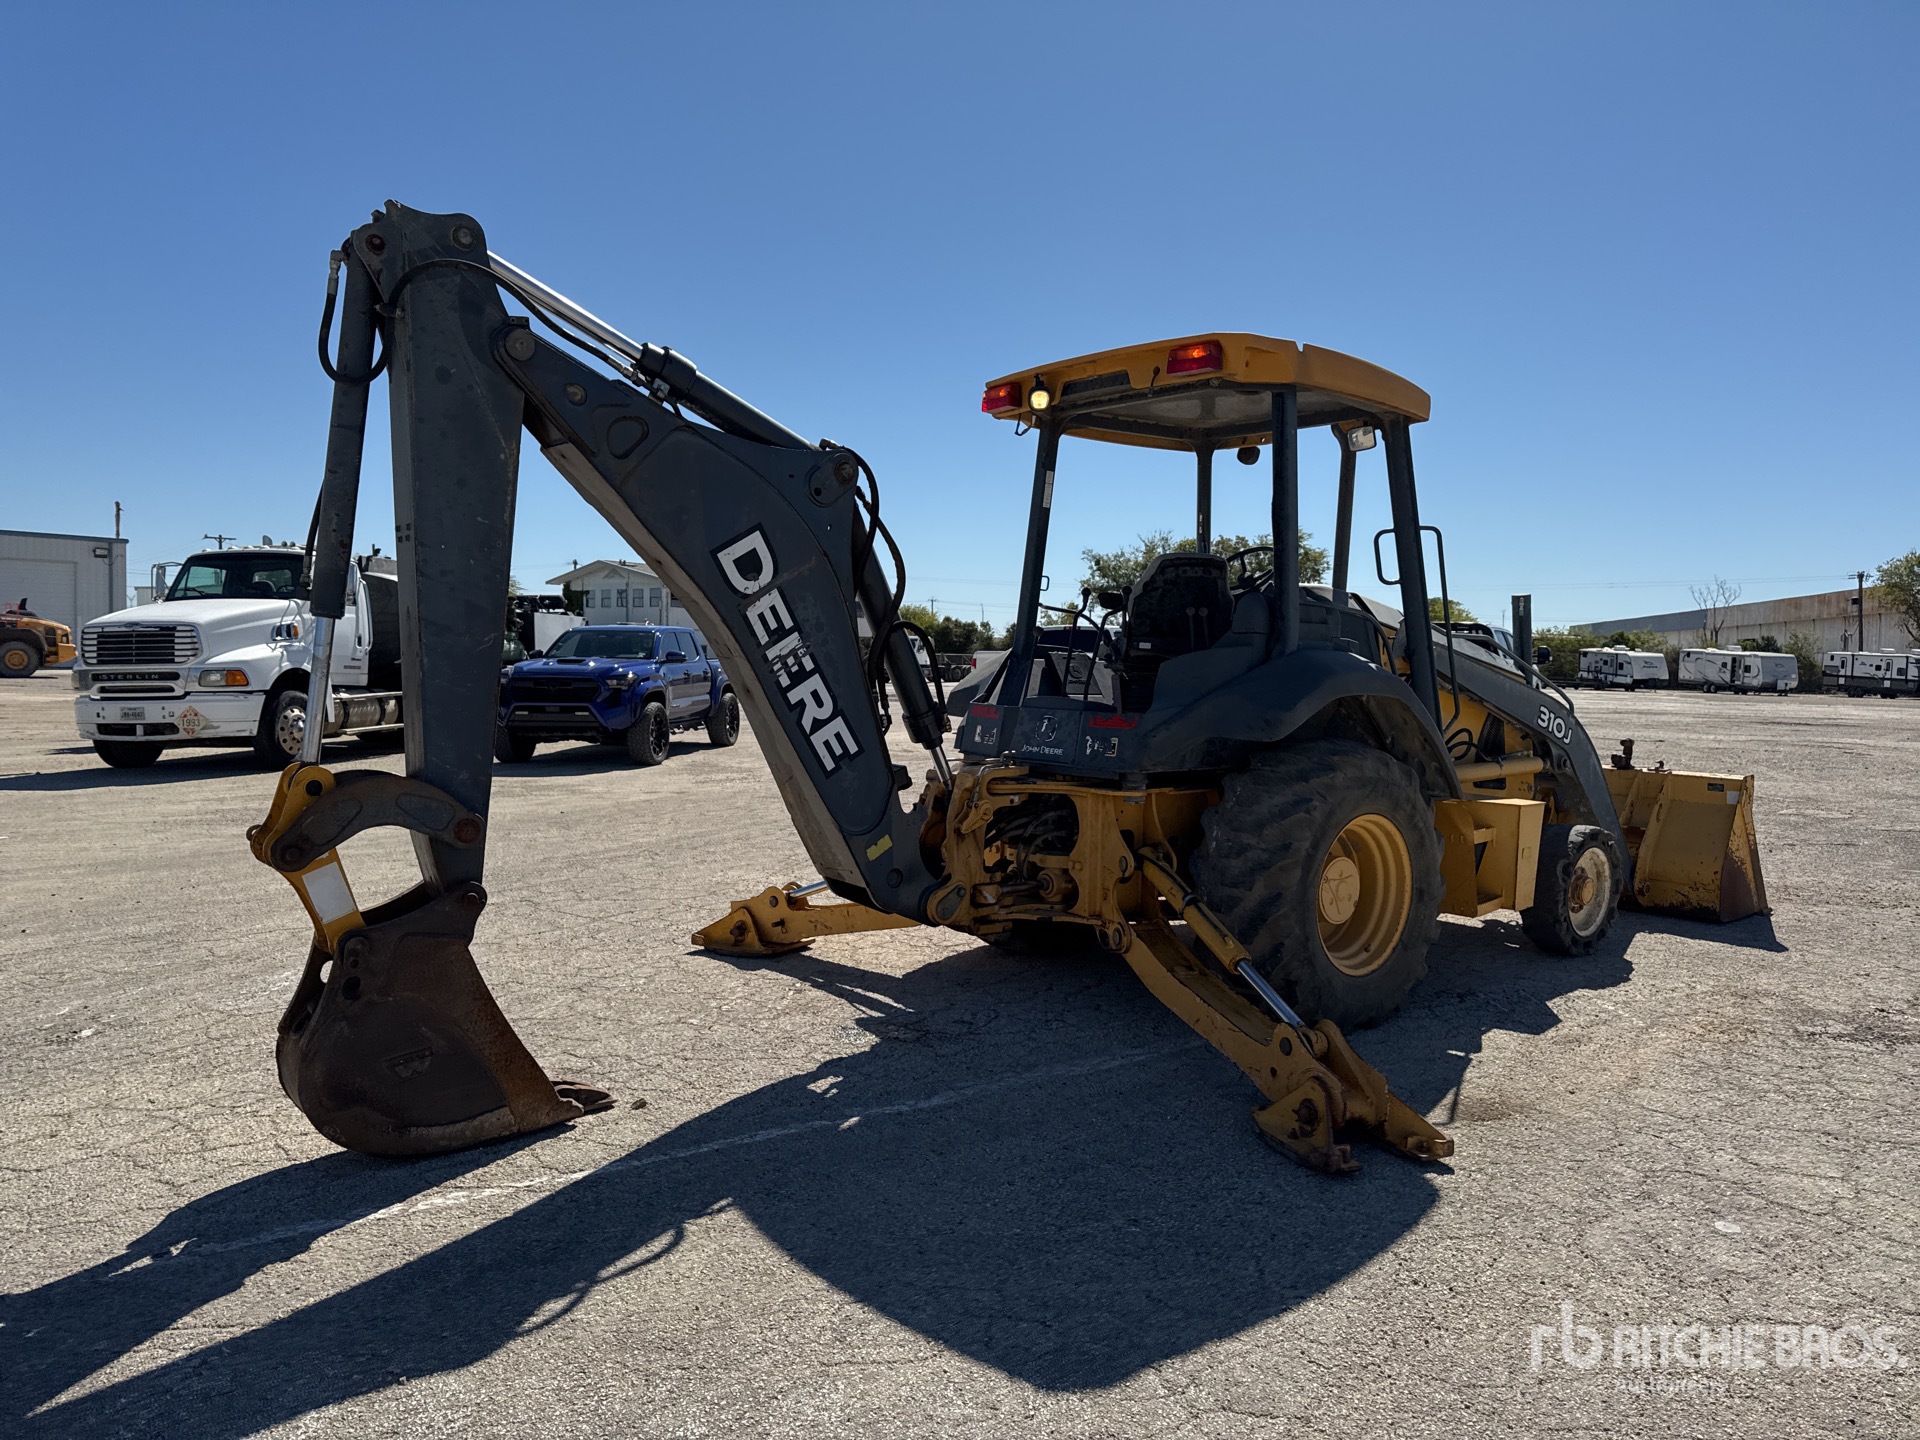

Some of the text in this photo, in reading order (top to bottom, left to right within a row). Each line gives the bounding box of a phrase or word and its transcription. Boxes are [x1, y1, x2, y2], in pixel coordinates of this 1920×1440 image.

[716, 529, 859, 772] DEERE
[181, 718, 201, 728] 1993
[1537, 706, 1572, 744] 310J
[1021, 744, 1063, 755] JOHN DEERE
